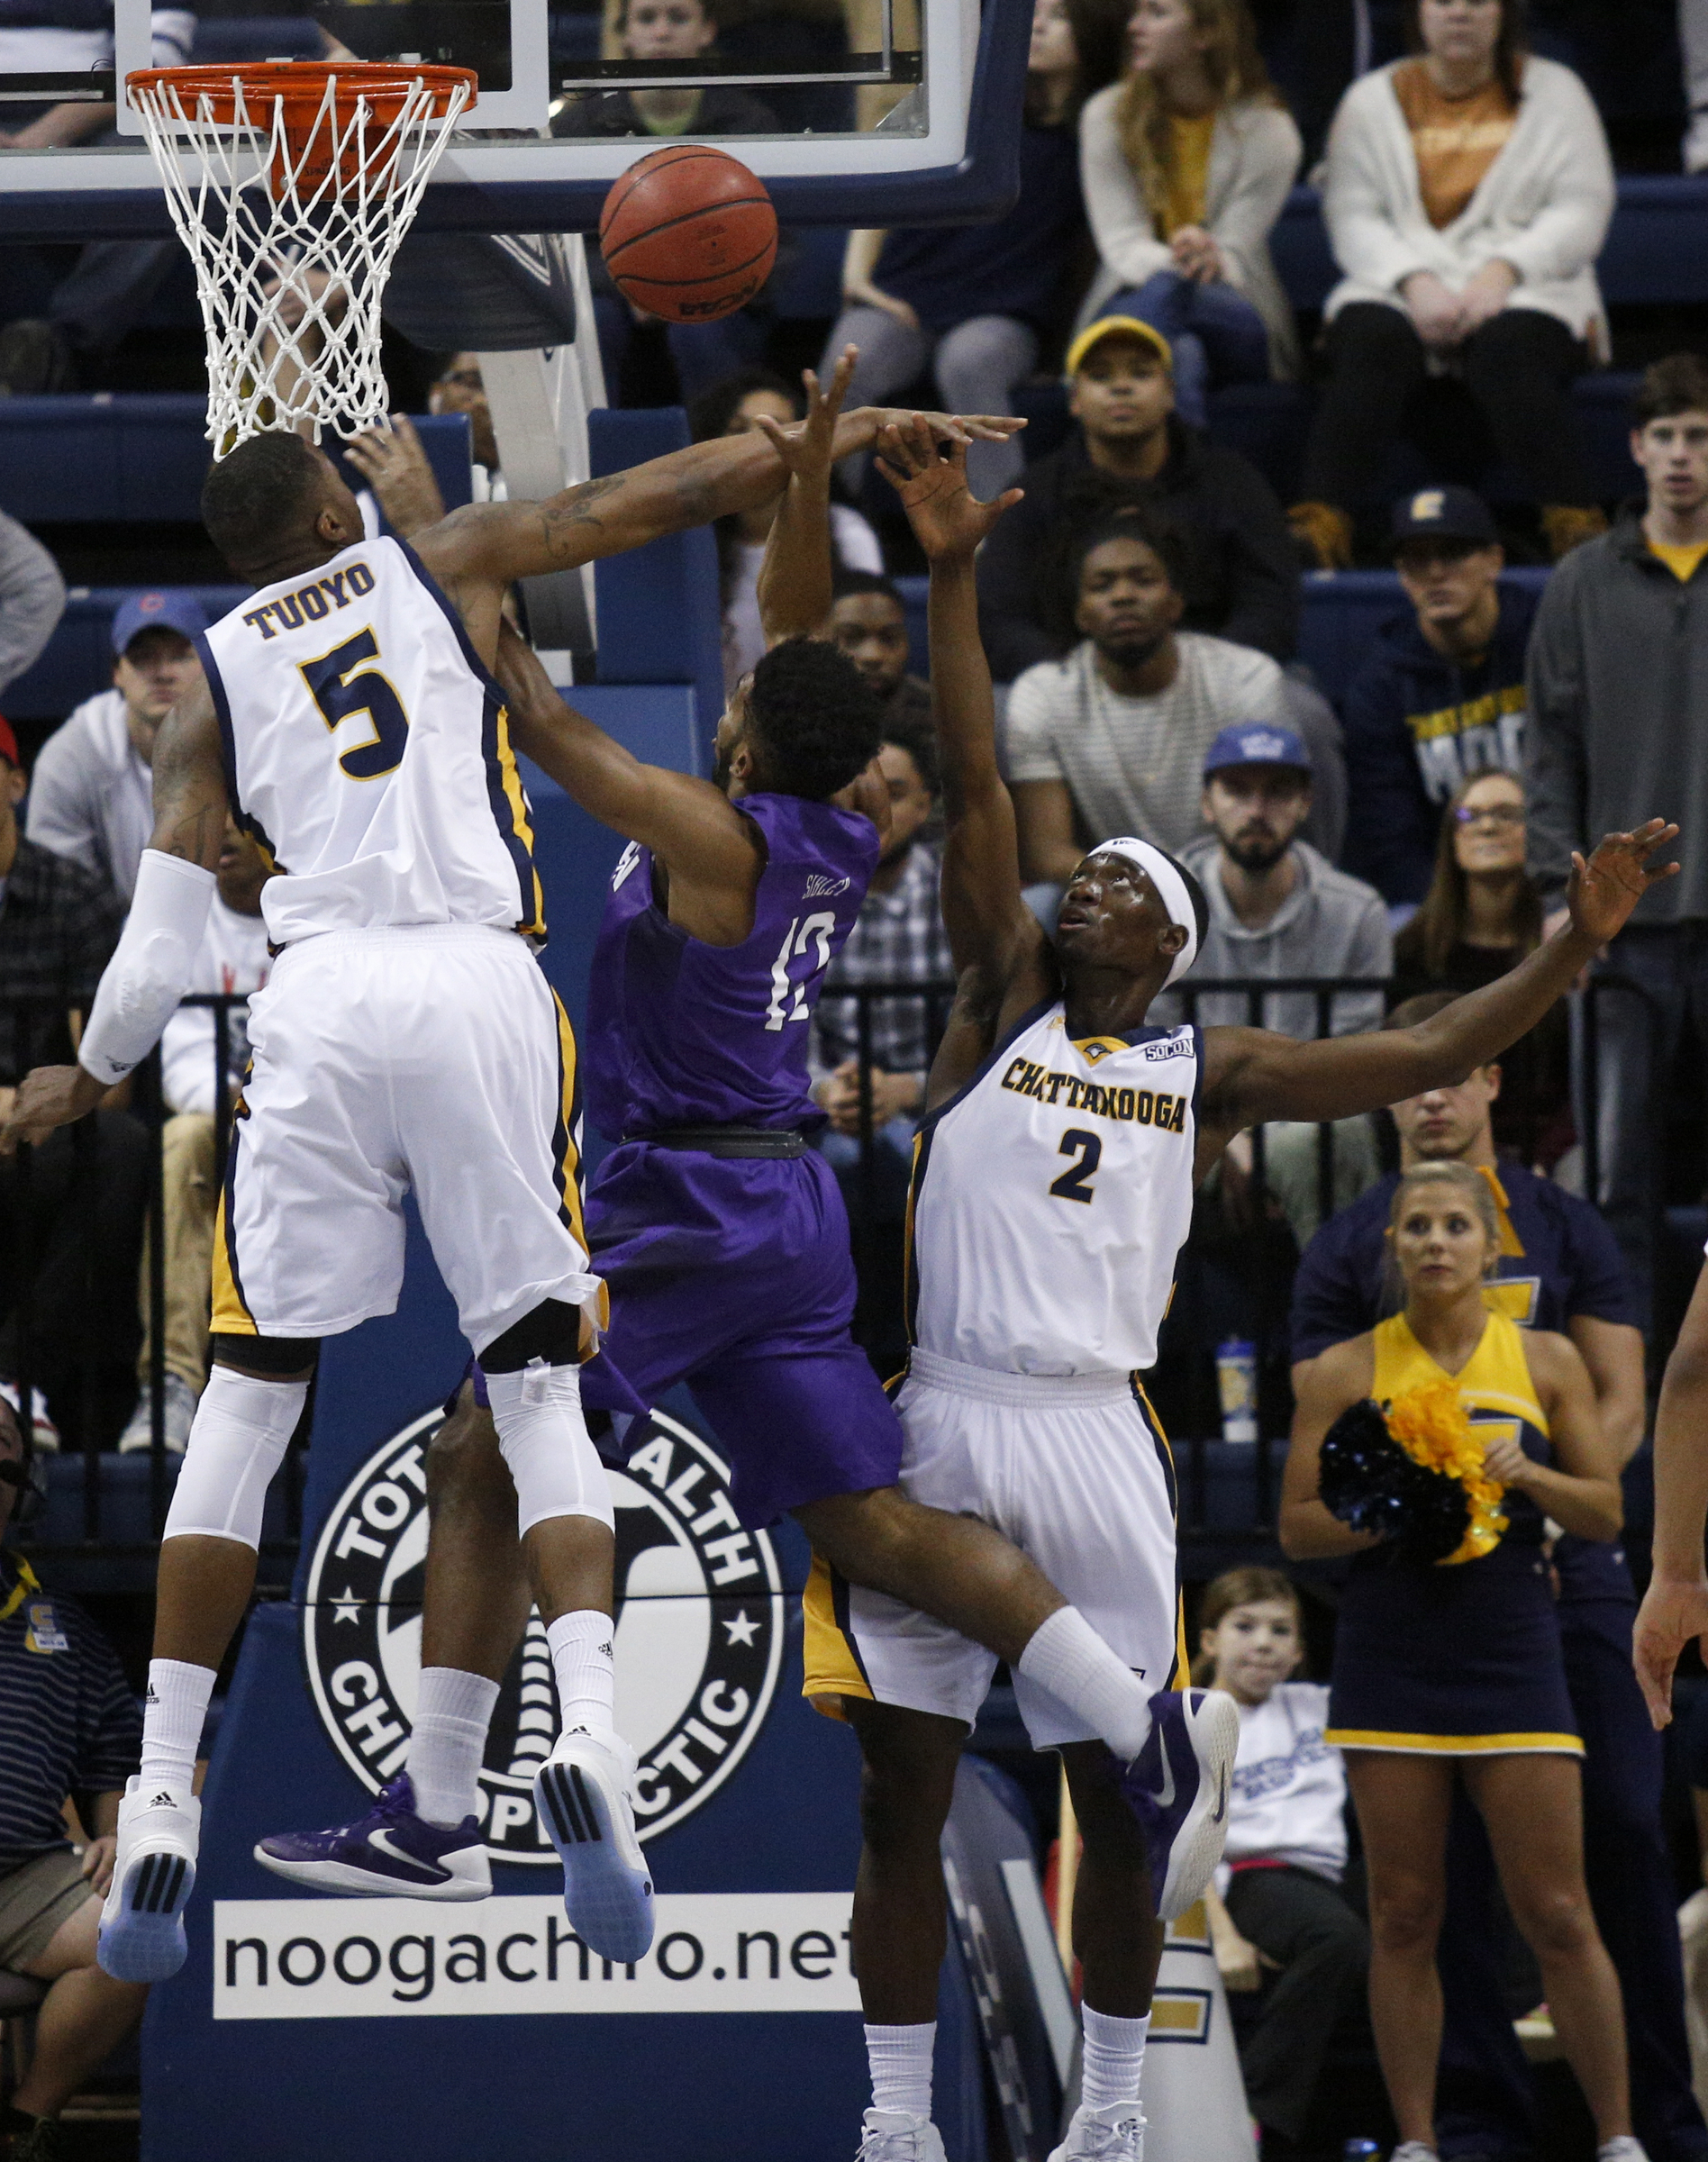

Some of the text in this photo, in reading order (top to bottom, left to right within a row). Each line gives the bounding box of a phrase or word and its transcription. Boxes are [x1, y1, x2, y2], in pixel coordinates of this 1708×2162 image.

[241, 561, 377, 640] TUOYO
[295, 623, 410, 782] 5
[765, 911, 836, 1031] 12
[1145, 1039, 1195, 1061] SOCON
[1001, 1057, 1187, 1134] CHATTANOOGA
[1049, 1128, 1102, 1204] 2
[335, 1435, 759, 1585] TOT ALTH
